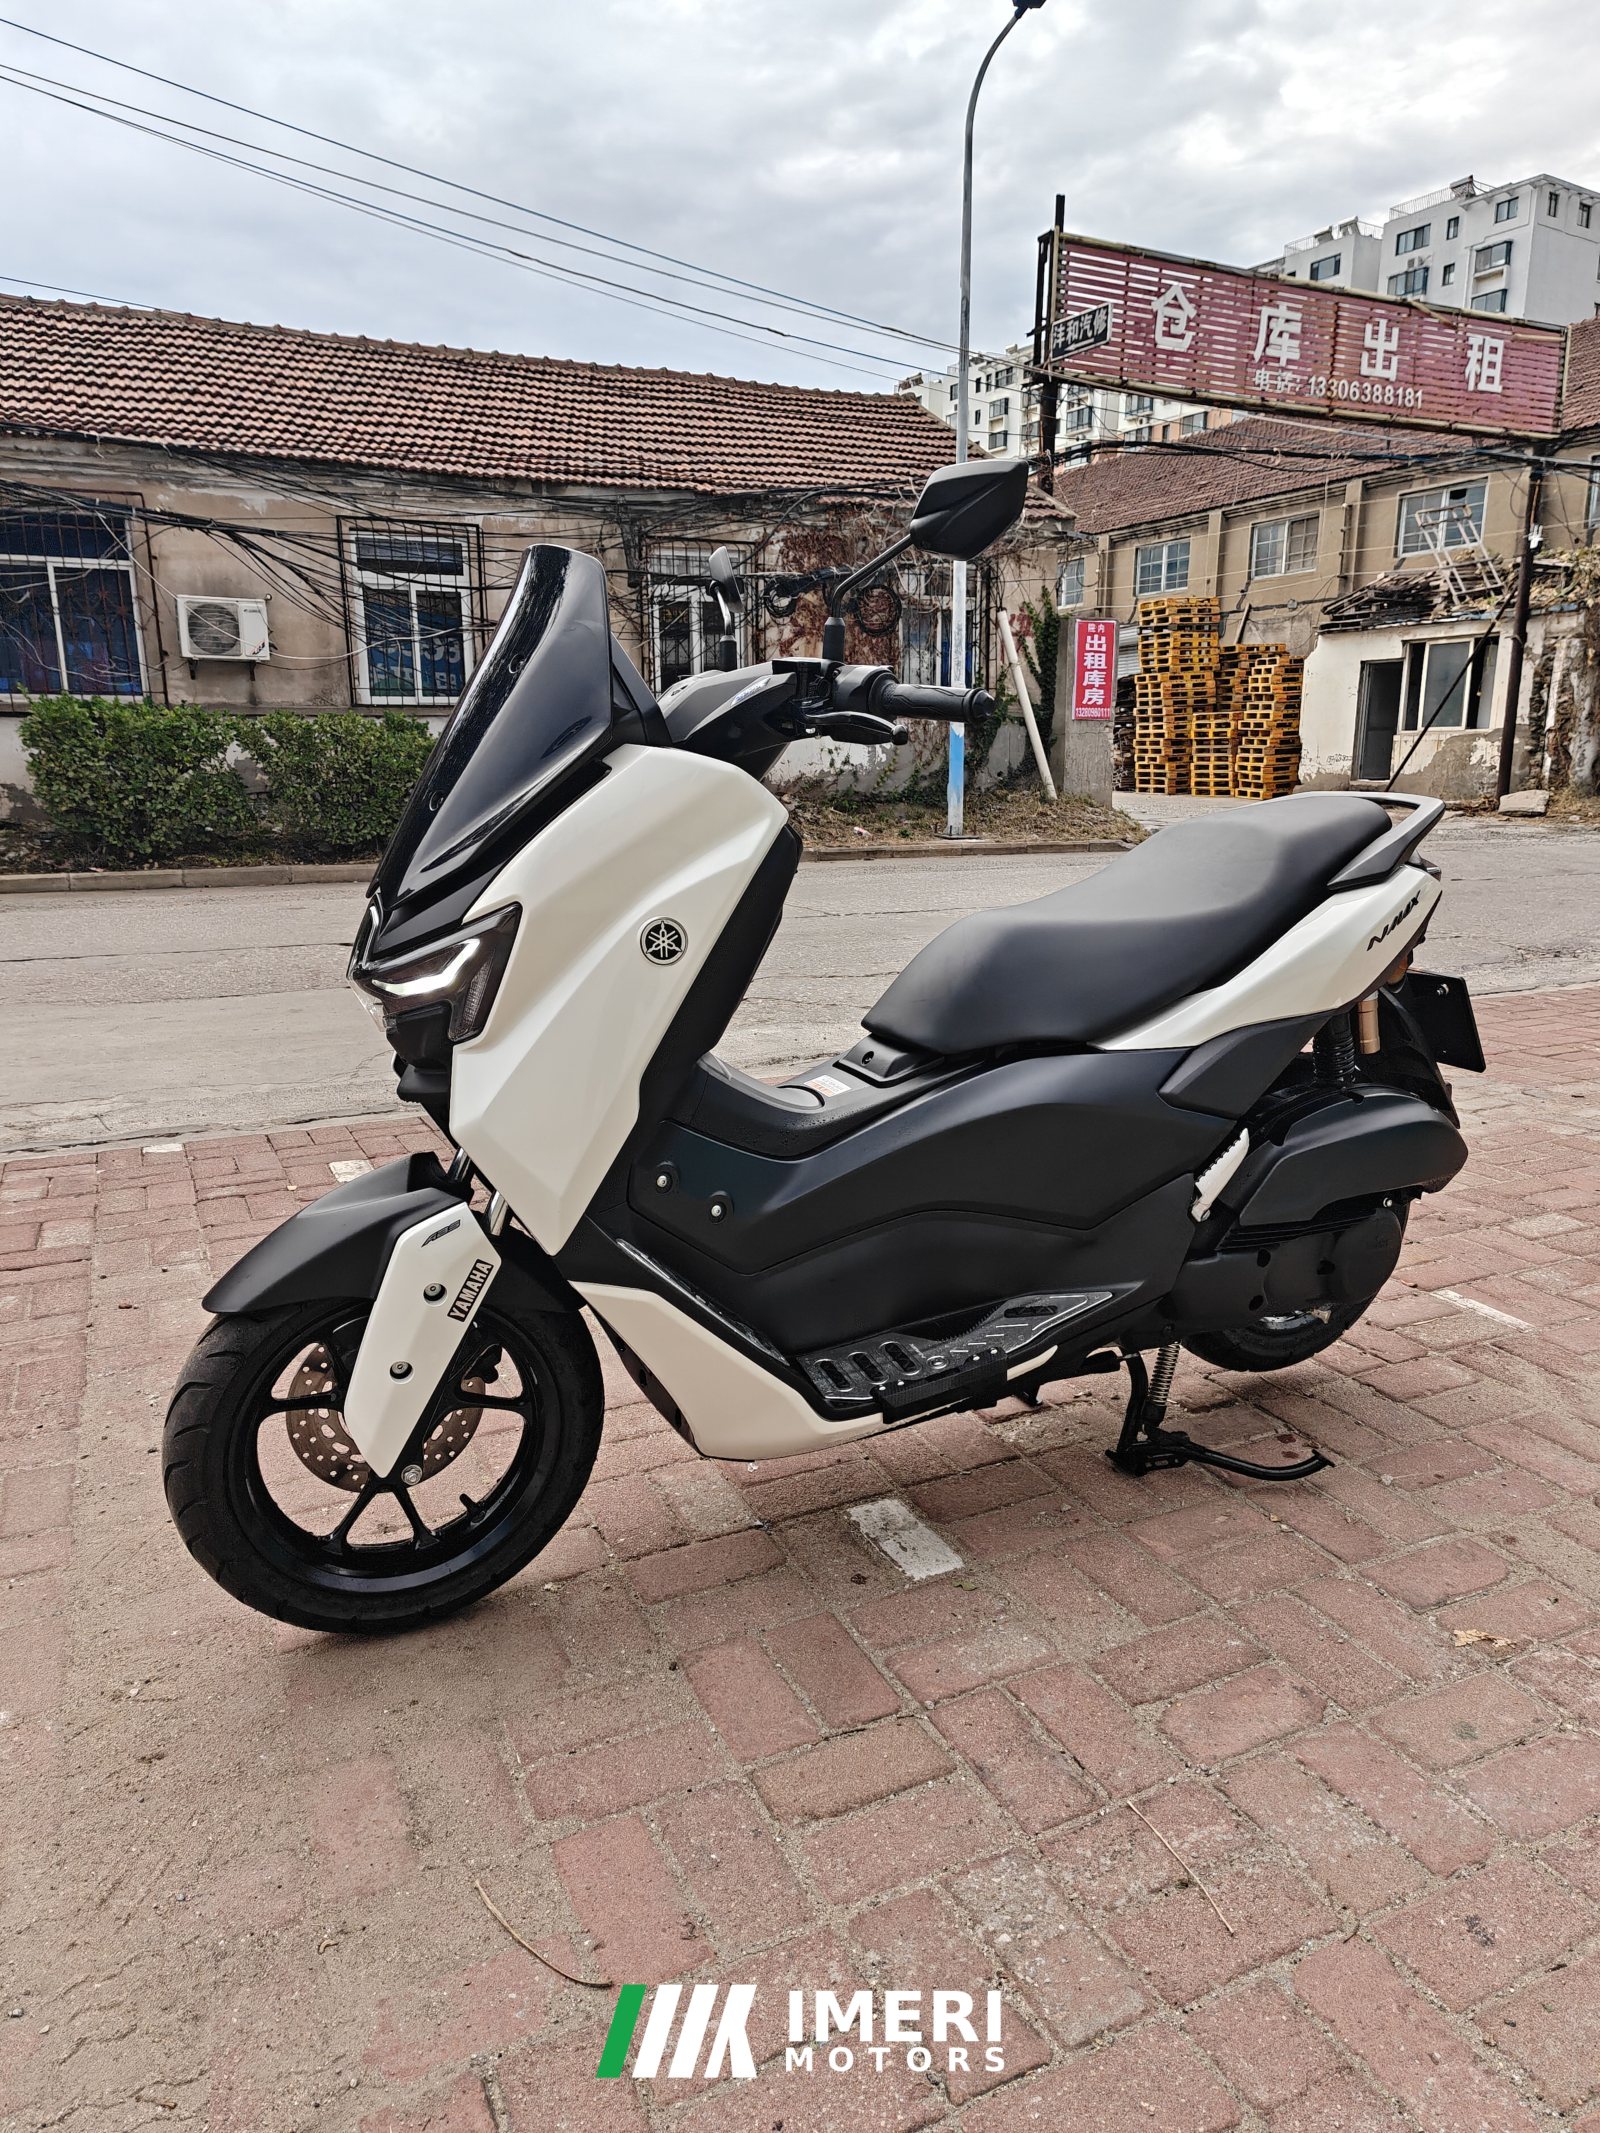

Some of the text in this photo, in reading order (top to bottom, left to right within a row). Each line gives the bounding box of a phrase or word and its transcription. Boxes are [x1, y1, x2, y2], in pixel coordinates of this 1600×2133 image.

[1150, 284, 1504, 393] 仓库出租
[1307, 374, 1423, 410] 13306388181
[1082, 634, 1107, 705] 出租库房
[449, 1260, 493, 1320] YAMAHA
